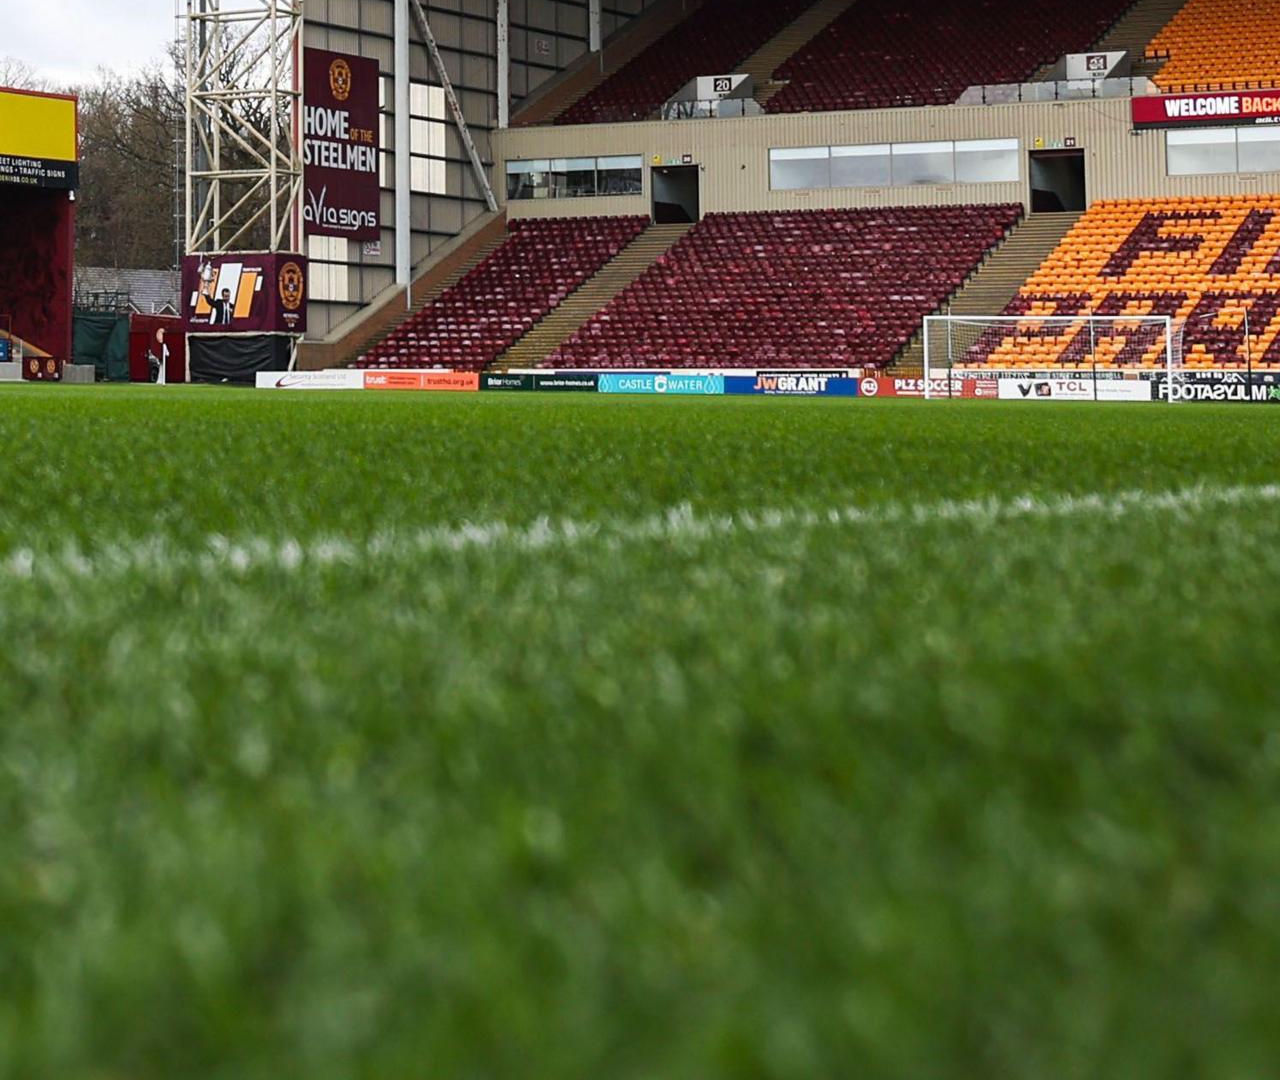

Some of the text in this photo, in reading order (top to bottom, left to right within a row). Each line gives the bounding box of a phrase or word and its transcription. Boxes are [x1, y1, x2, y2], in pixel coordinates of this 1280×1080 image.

[716, 80, 729, 91] 20
[1165, 97, 1239, 117] WELCOME
[304, 106, 349, 140] HOME
[350, 128, 373, 143] OF THE
[304, 138, 376, 173] STEELMEN
[12, 158, 42, 168] LIGHTING
[19, 167, 45, 176] TRAFFIC
[47, 170, 65, 178] SIGNS
[366, 375, 387, 384] trust
[618, 379, 702, 390] CASTLE WATER
[894, 379, 915, 391] PLZ
[1057, 381, 1087, 391] TCL
